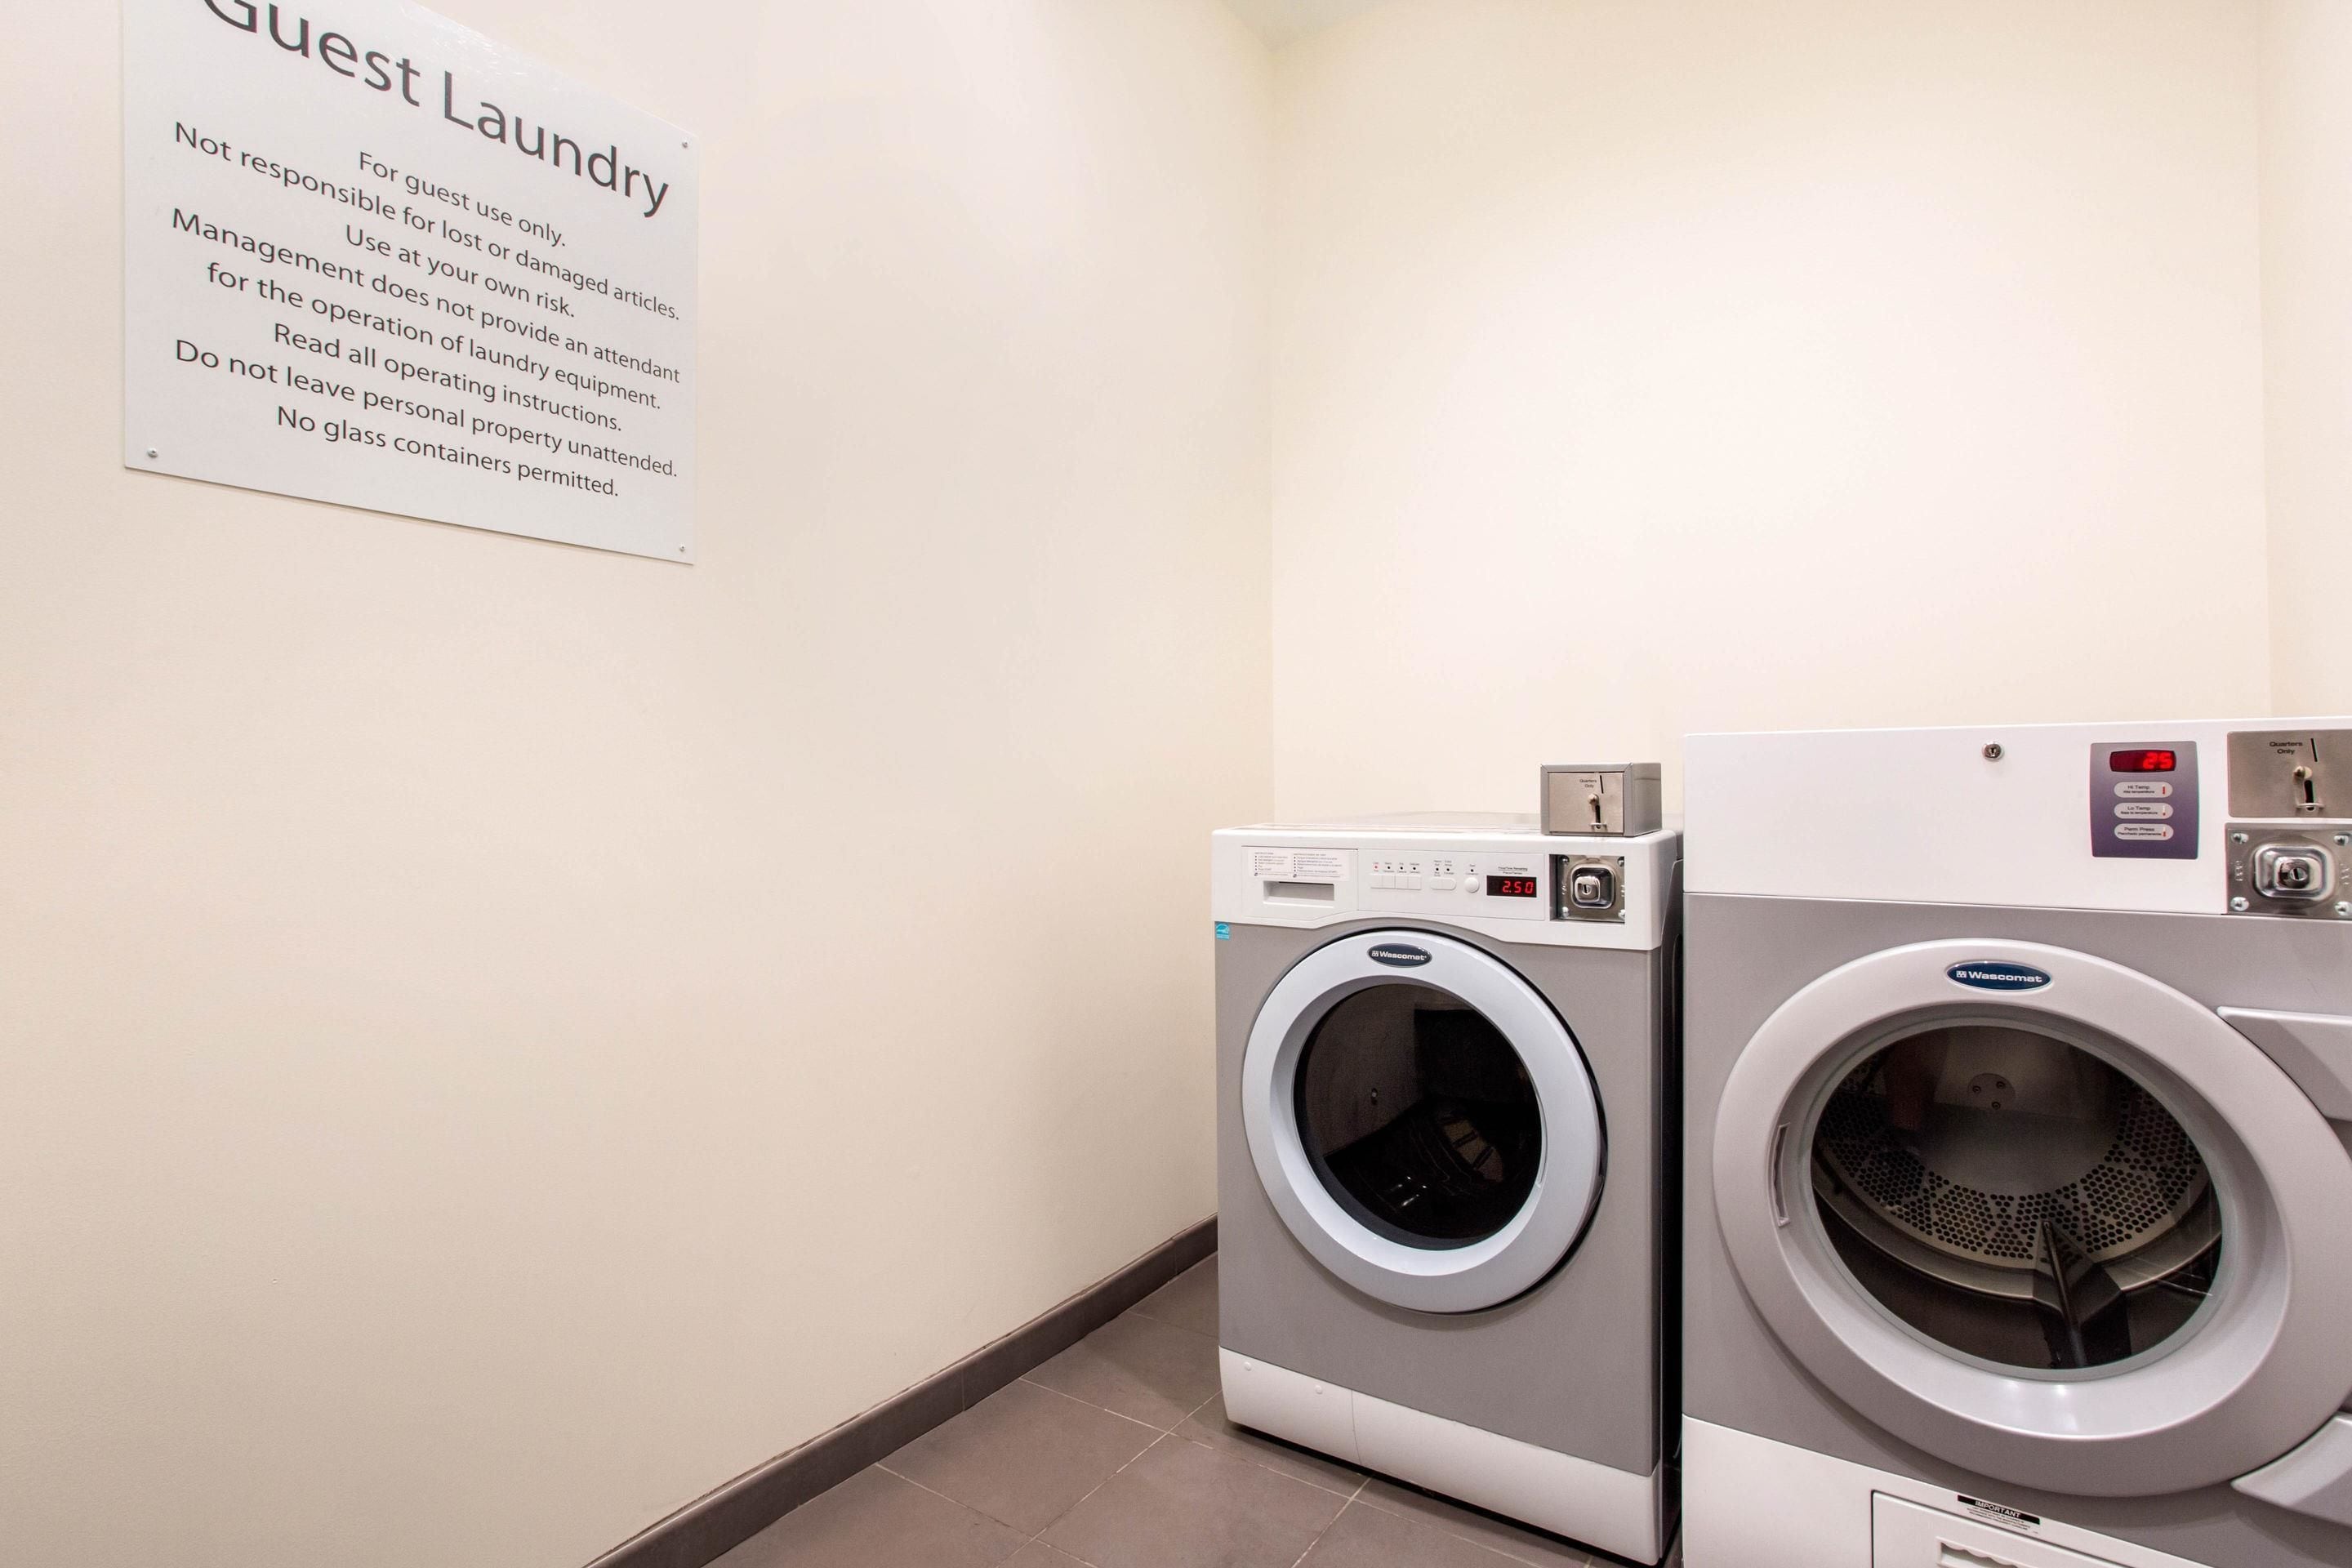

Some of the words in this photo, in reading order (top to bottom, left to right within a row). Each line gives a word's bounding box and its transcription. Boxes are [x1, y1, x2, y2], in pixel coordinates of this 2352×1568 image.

[443, 70, 670, 218] Laundry
[176, 121, 232, 162] Not
[241, 151, 396, 220] responsible
[402, 206, 436, 234] for
[443, 219, 483, 252] lost
[488, 243, 510, 261] or
[515, 249, 608, 296] damaged
[613, 287, 679, 321] articles.
[359, 151, 399, 182] For
[405, 175, 470, 211] guest
[476, 201, 513, 227] use
[518, 219, 566, 247] only.
[172, 207, 365, 287] Management
[372, 274, 430, 307] does
[437, 296, 475, 321] not
[481, 310, 560, 347] provide
[564, 337, 588, 356] an
[593, 346, 680, 384] attendant
[346, 224, 391, 257] Use
[398, 247, 421, 268] at
[427, 256, 479, 285] your
[484, 277, 530, 303] own
[537, 292, 575, 318] risk.
[207, 261, 249, 292] for
[256, 278, 304, 309] the
[311, 299, 433, 346] operation
[440, 335, 465, 354] of
[470, 338, 550, 381] laundry
[555, 369, 661, 410] equipment.
[274, 323, 341, 359] Read
[348, 345, 376, 368] all
[384, 358, 496, 403] operating
[503, 385, 621, 432] instructions.
[176, 339, 220, 368] Do
[229, 358, 278, 384] not
[287, 365, 355, 402] leave
[363, 390, 465, 428] personal
[472, 417, 563, 454] property
[568, 440, 678, 479] unattended.
[278, 405, 316, 432] No
[323, 419, 386, 448] glass
[394, 437, 511, 474] containers
[518, 463, 618, 497] permitted.
[2142, 751, 2173, 769] 25
[1502, 880, 1535, 895] 2.50
[1379, 951, 1426, 960] Wascomat
[1967, 970, 2043, 983] Wascomat
[1975, 1500, 2021, 1518] IMPORTANT
